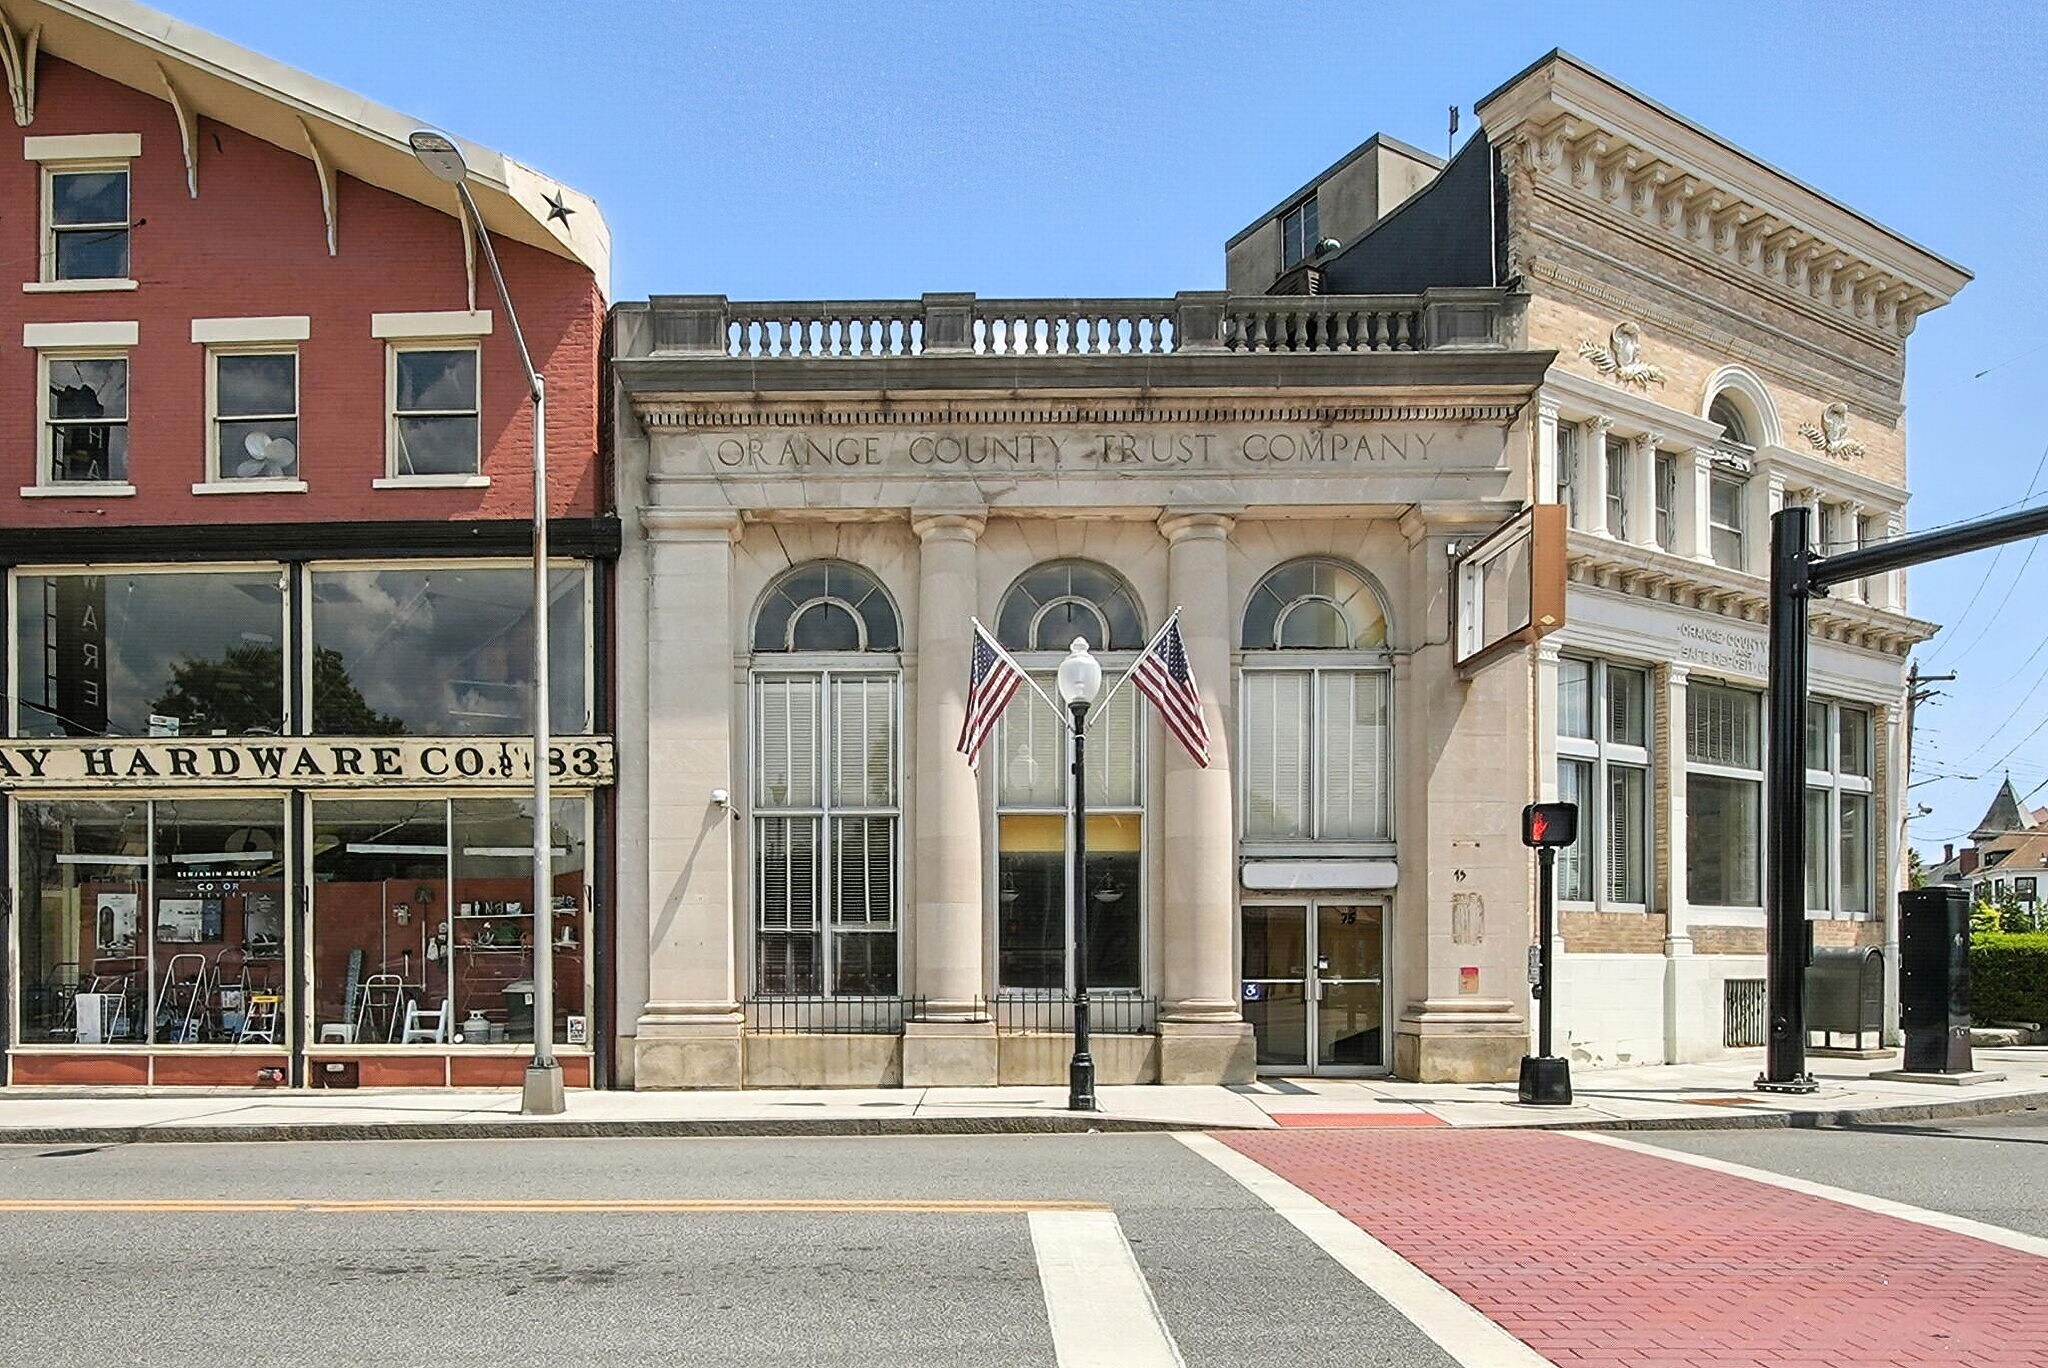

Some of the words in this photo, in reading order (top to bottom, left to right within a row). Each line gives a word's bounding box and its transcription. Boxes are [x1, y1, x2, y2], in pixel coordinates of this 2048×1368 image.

[716, 436, 881, 467] ORANGE
[908, 435, 1069, 466] COUNTY
[1095, 433, 1217, 464] TRUST
[1242, 431, 1436, 463] COMPANY
[1680, 623, 1723, 644] ORANGE
[1727, 633, 1767, 653] COUNTY
[81, 747, 403, 777] HARDWARE
[420, 746, 497, 777] CO.
[197, 882, 240, 891] COOR
